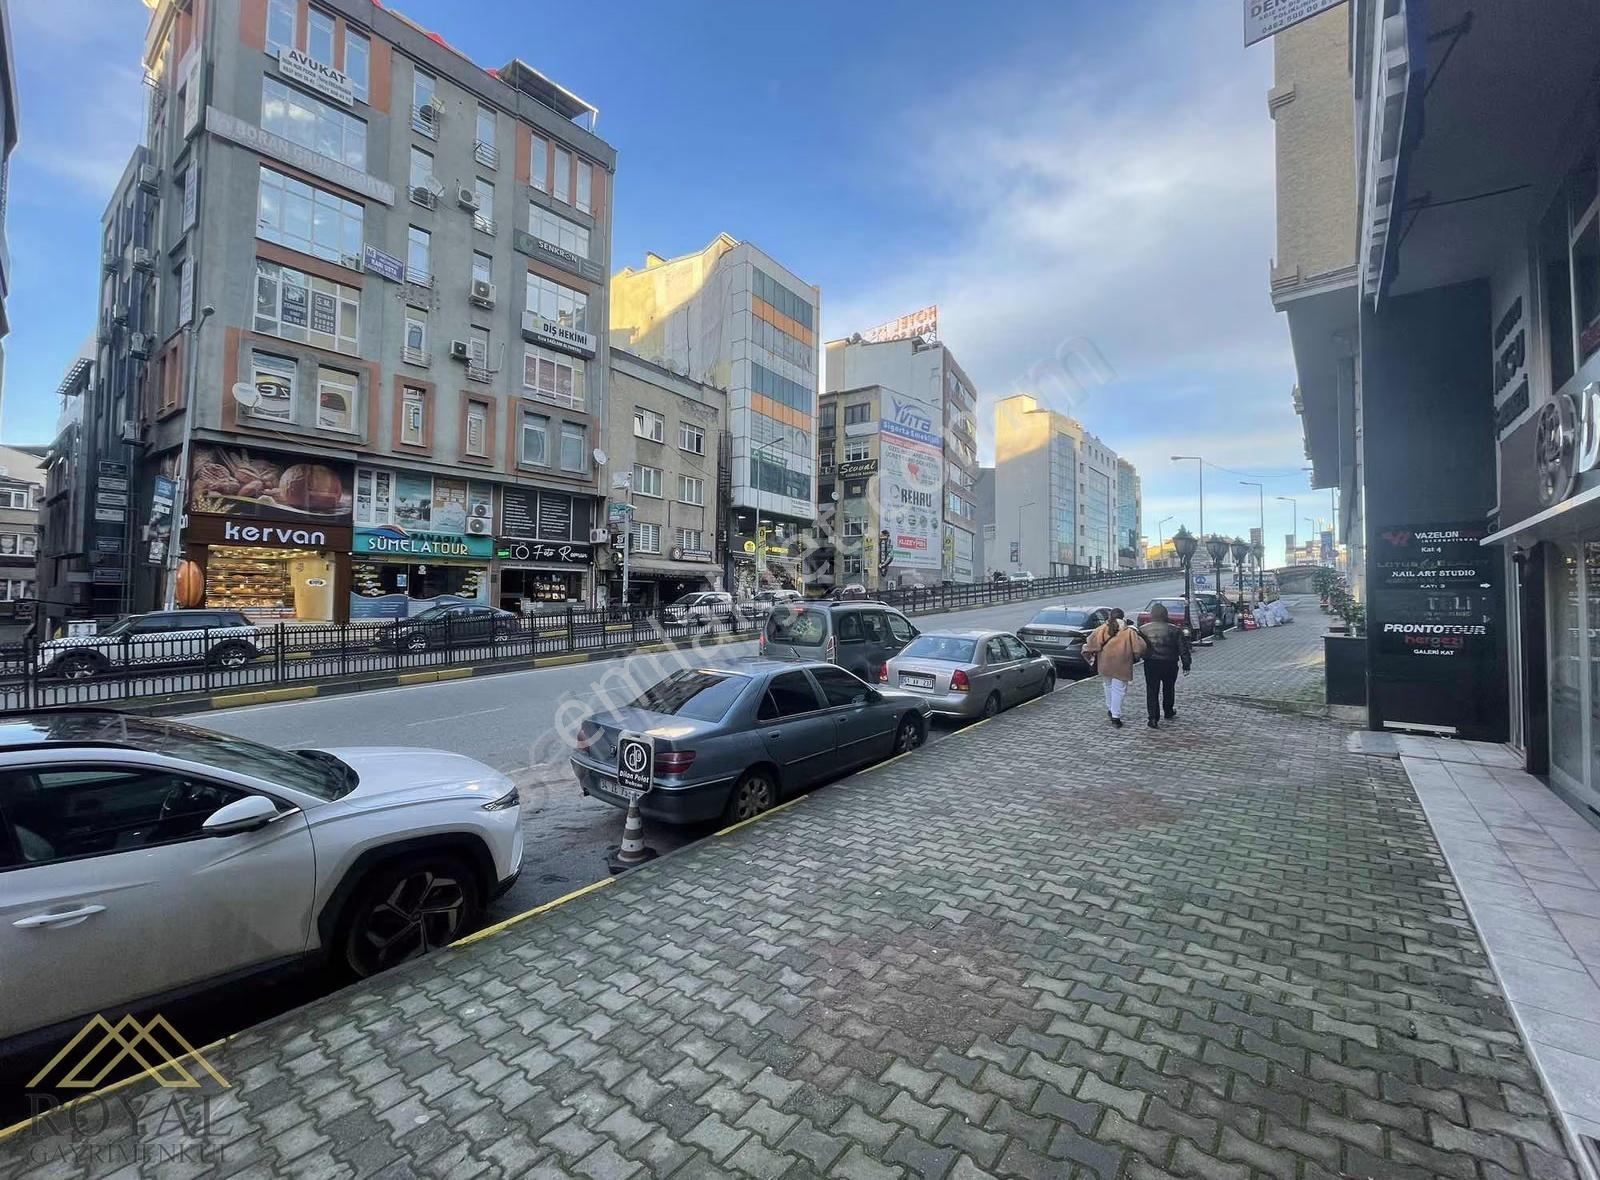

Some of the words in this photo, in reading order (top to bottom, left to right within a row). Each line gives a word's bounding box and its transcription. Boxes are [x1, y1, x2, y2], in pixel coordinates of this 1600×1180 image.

[289, 50, 346, 83] AVUKAT
[538, 240, 577, 262] SENKRON
[543, 323, 557, 337] DİŞ
[558, 328, 588, 345] HEKİMİ
[901, 488, 932, 507] REHAU
[225, 521, 325, 545] kervan
[1414, 530, 1459, 539] VAZELON
[1439, 569, 1476, 577] STUDIO
[1383, 623, 1487, 635] PRONTOTOUR
[620, 770, 634, 779] Dilan
[634, 773, 650, 783] Polat
